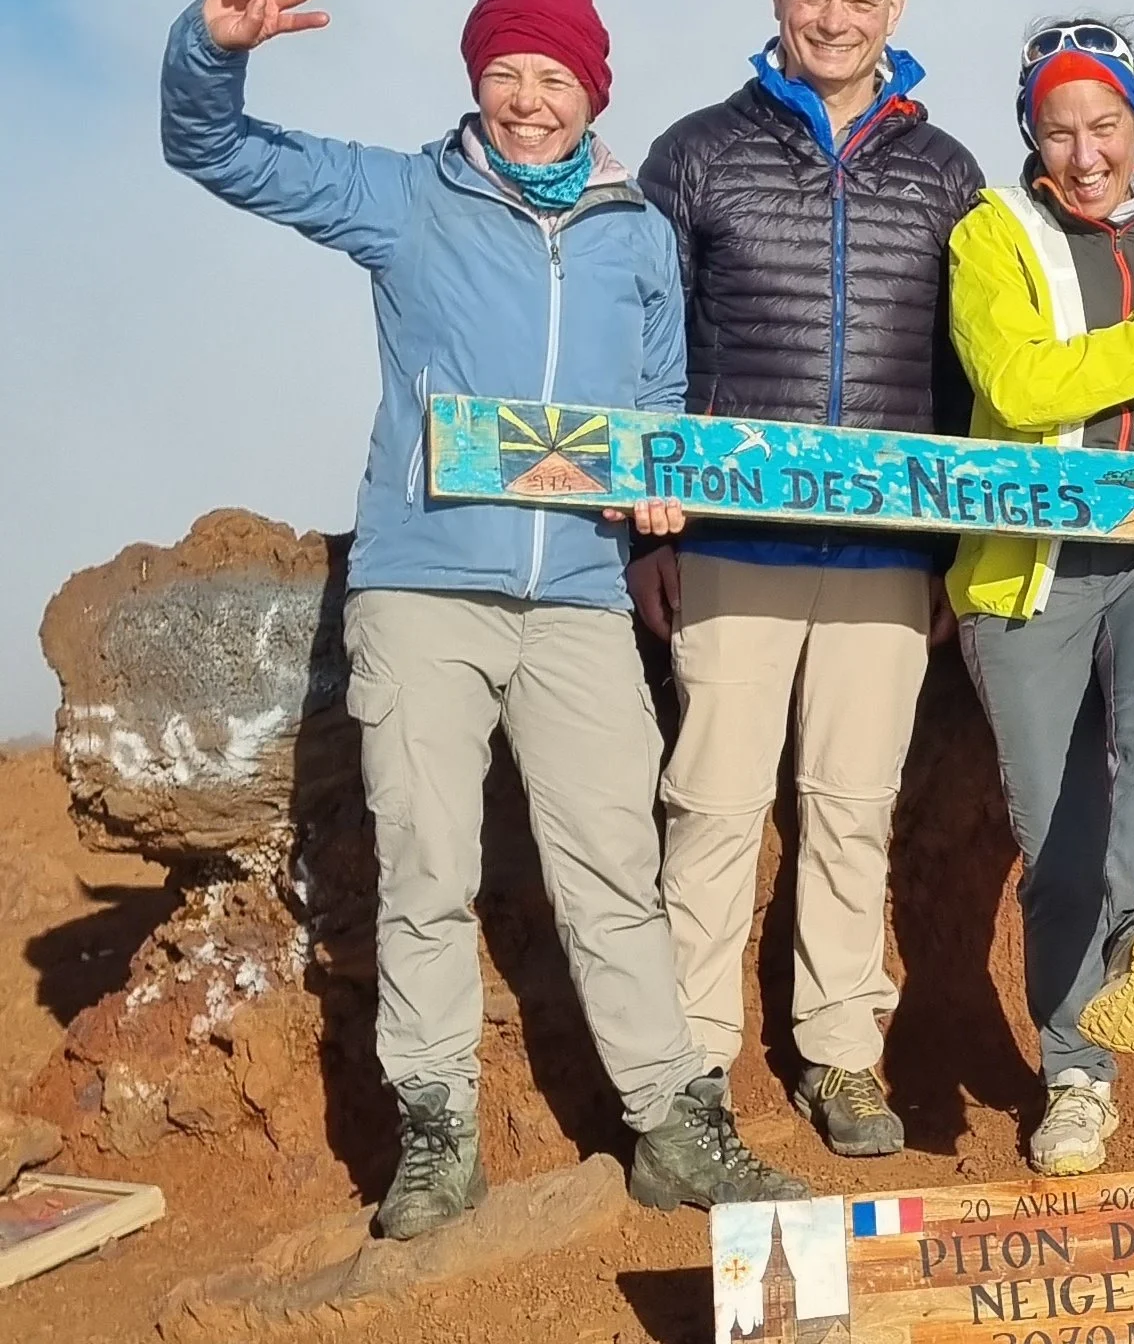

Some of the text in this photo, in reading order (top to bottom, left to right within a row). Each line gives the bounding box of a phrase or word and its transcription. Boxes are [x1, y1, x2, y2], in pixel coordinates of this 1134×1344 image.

[780, 467, 885, 515] DES
[960, 1199, 991, 1224] 20
[1013, 1191, 1086, 1220] AVRIL
[917, 1226, 1071, 1278] PITON
